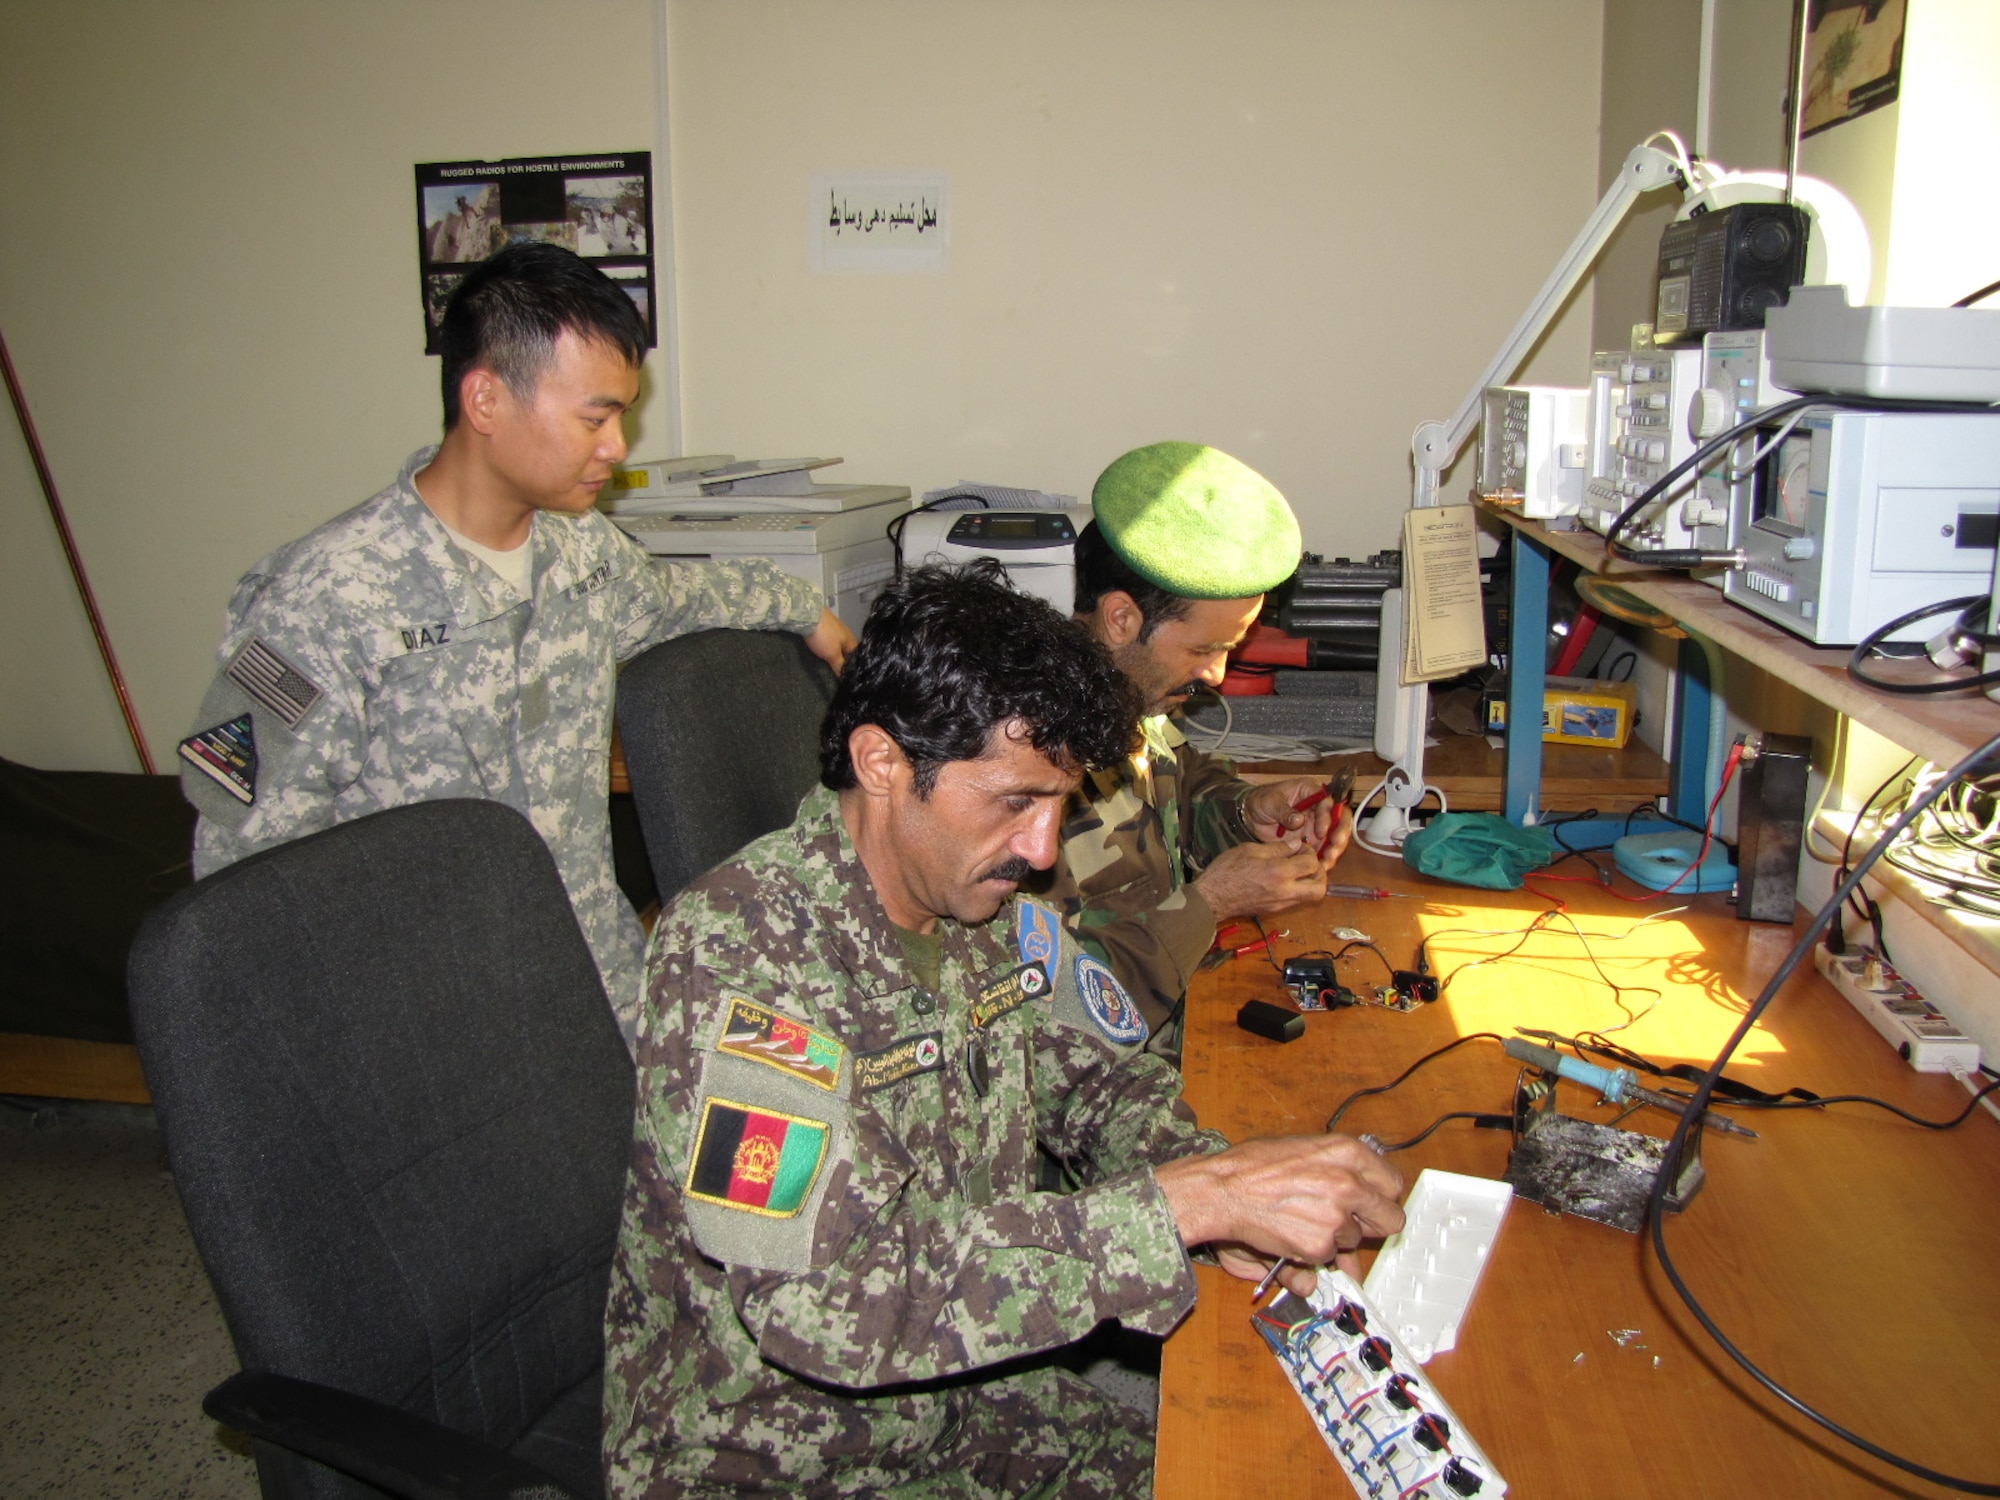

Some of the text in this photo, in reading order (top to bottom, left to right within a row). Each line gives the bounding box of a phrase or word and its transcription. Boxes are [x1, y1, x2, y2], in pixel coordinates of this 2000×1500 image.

[440, 160, 626, 178] RUGGED RADIOS FOR HOSTILE ENVIRONMENTS
[401, 623, 451, 650] DIAZ
